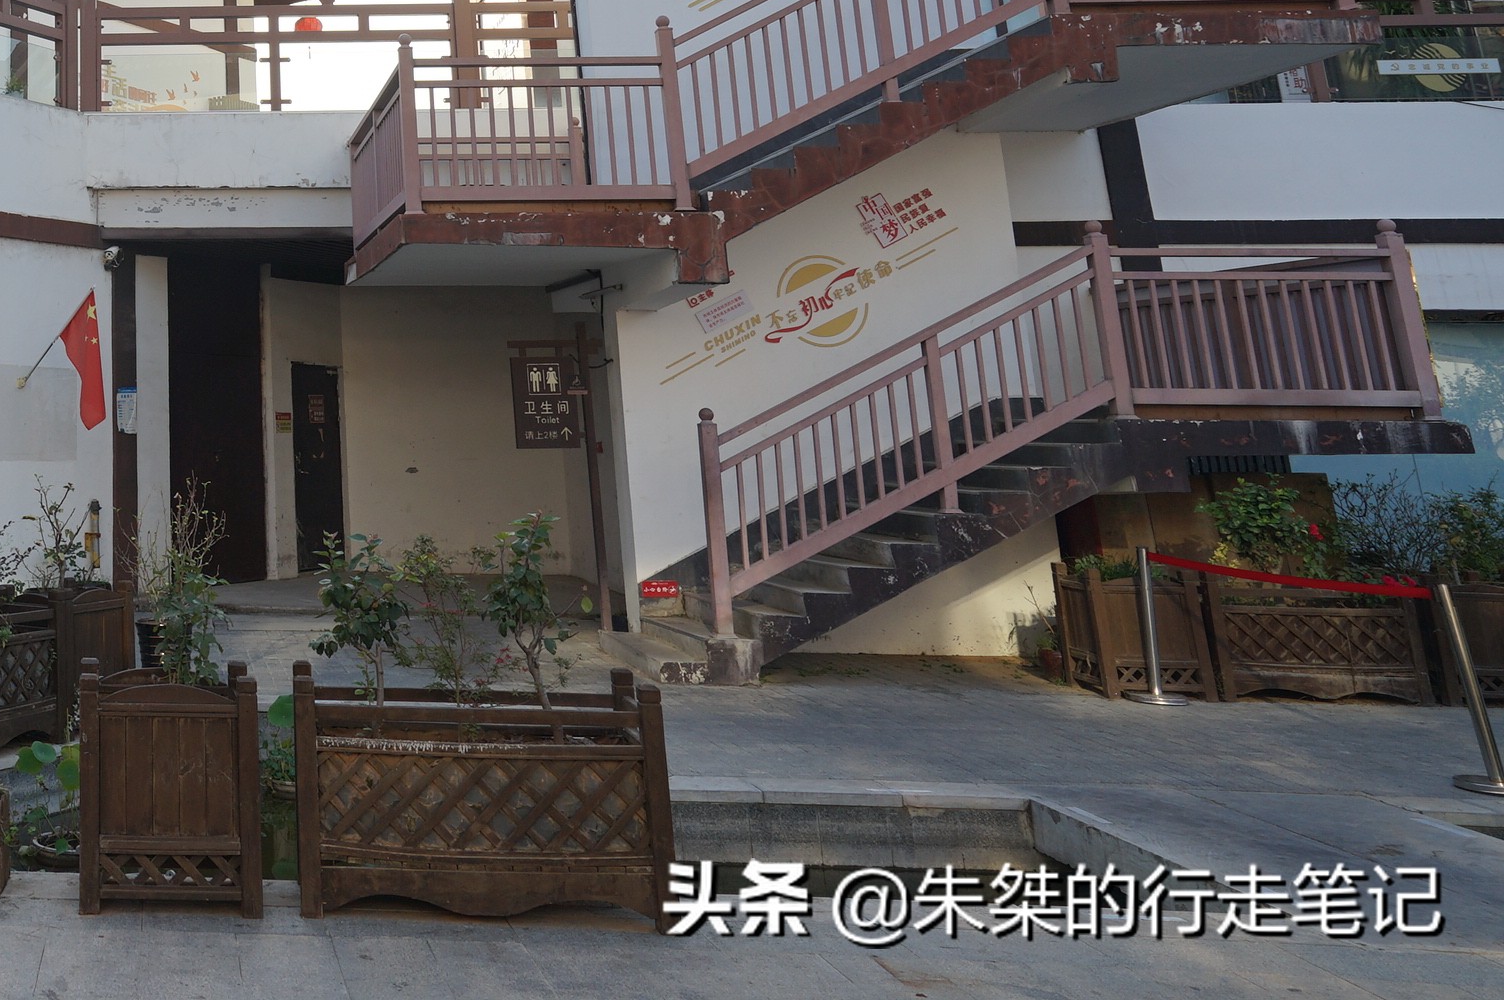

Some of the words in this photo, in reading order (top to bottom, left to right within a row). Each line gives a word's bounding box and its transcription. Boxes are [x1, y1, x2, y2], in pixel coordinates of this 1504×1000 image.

[893, 187, 934, 214] 国家富强
[909, 208, 947, 234] 人民幸福
[704, 313, 762, 352] CHUXIN
[523, 400, 570, 415] 卫生间
[534, 415, 560, 424] Toilet
[524, 430, 558, 440] 请上2楼
